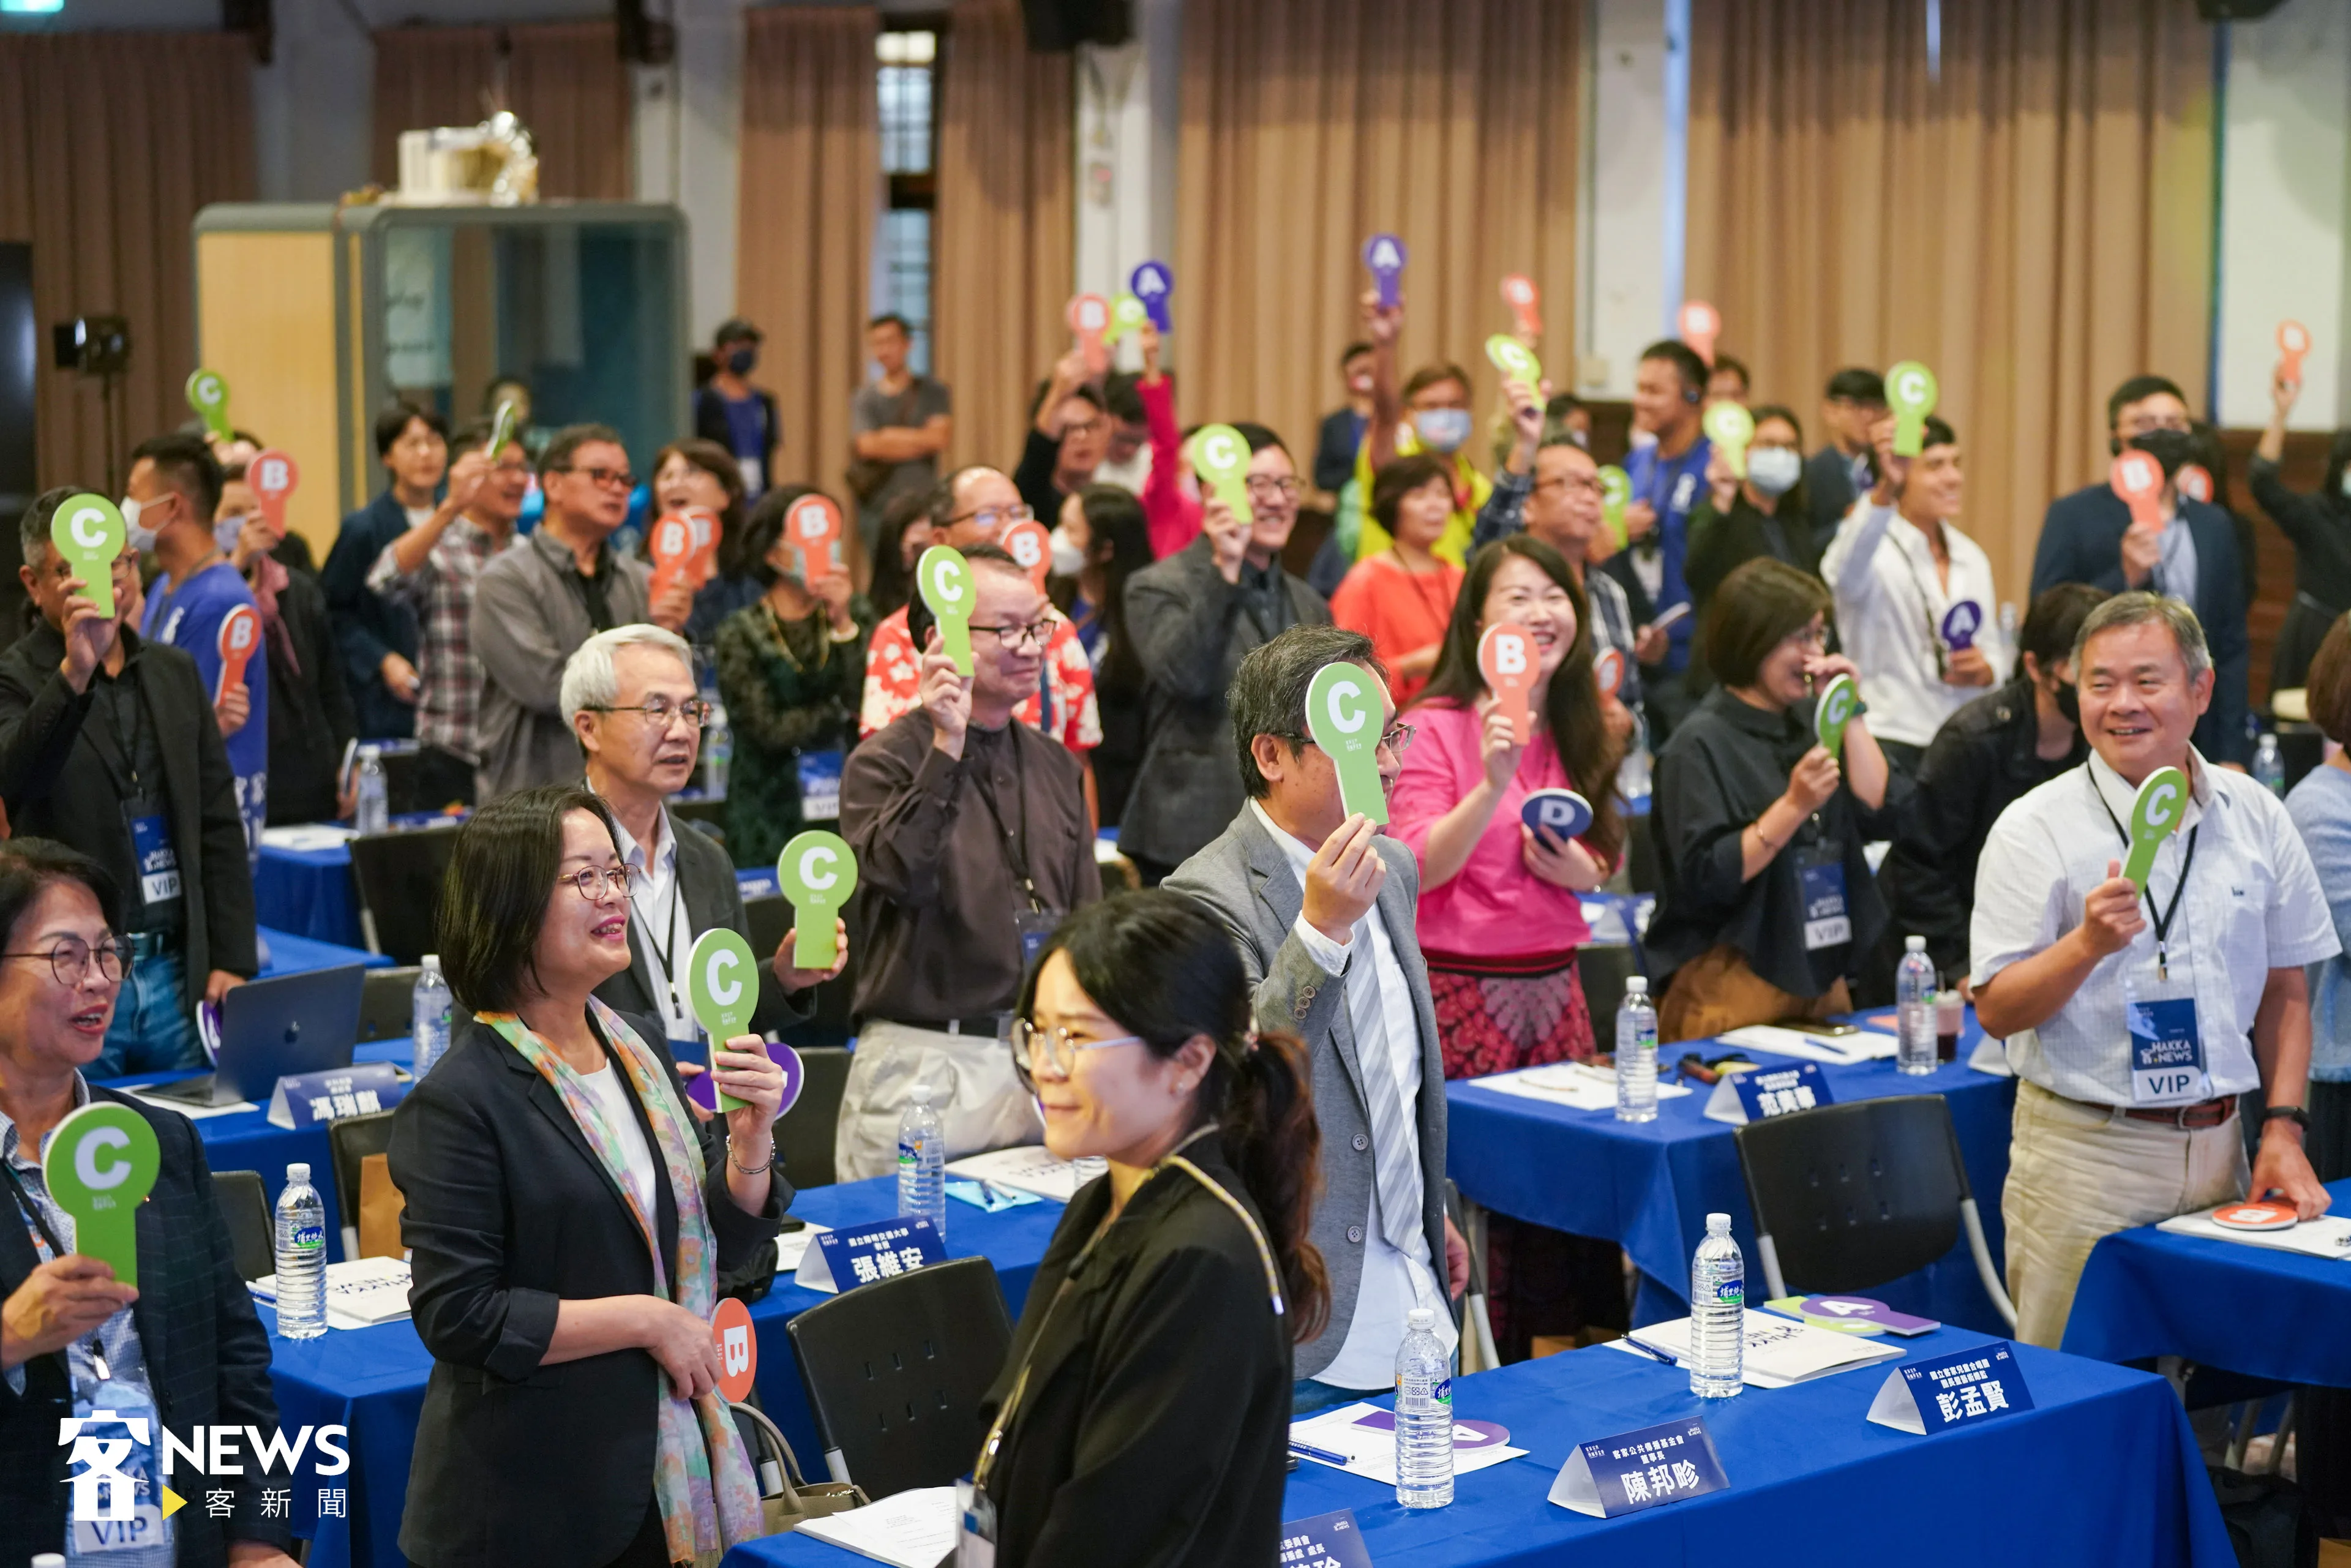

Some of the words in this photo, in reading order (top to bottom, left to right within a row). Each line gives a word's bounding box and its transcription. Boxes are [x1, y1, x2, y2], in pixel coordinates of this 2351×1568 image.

[1372, 239, 1401, 267] A
[1136, 266, 1166, 294] A
[197, 377, 222, 405] C
[1899, 371, 1927, 405] C
[1204, 436, 1237, 468] C
[261, 459, 288, 490] B
[70, 508, 108, 549] C
[659, 522, 685, 556] B
[798, 505, 829, 539] B
[1011, 531, 1041, 568] B
[932, 559, 964, 602] C
[230, 615, 253, 650] B
[1948, 604, 1975, 637] A
[1495, 634, 1527, 675] B
[1326, 680, 1366, 733] C
[1824, 689, 1851, 724] C
[1537, 799, 1576, 827] D
[2145, 784, 2178, 827] C
[798, 846, 839, 890] C
[152, 877, 178, 895] VIP
[705, 948, 743, 1006] C
[2151, 1039, 2192, 1052] HAKKA
[2158, 1050, 2193, 1063] NEWS
[2148, 1075, 2190, 1094] VIP
[73, 1125, 133, 1190] C
[850, 1246, 925, 1284] 張維安
[1819, 1300, 1874, 1316] A
[722, 1324, 749, 1378] B
[1935, 1379, 2009, 1424] 彭孟賢
[1611, 1434, 1685, 1460] 客家公共傳播基金會
[1640, 1450, 1666, 1465] 董事長
[1620, 1458, 1700, 1505] 陳邦畛
[91, 1516, 149, 1545] VIP
[1307, 1542, 1326, 1556] 處長
